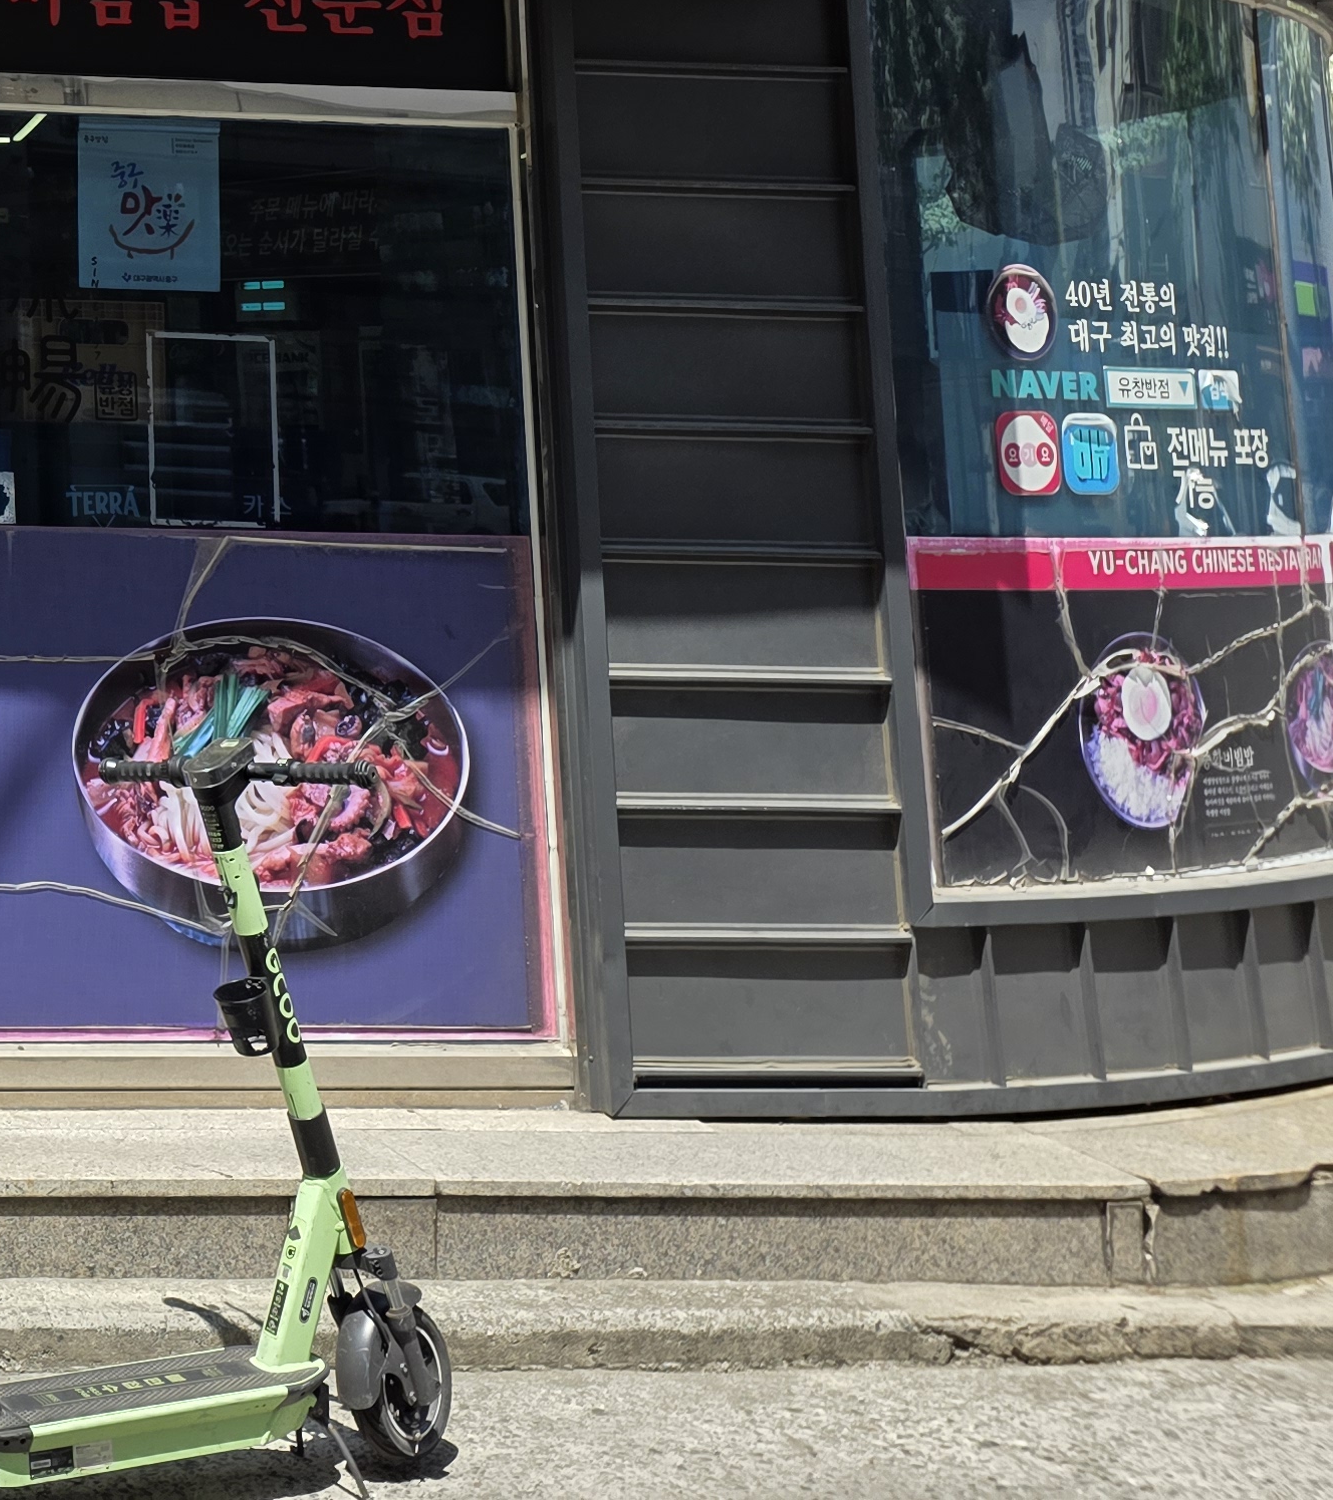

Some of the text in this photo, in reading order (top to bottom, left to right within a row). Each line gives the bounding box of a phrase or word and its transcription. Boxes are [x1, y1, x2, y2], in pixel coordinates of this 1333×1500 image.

[1065, 280, 1176, 315] 40년 전통의
[1068, 320, 1230, 358] 대구 최고의 맛집!!
[991, 369, 1100, 400] NAVER
[1118, 377, 1170, 399] 유창반점
[1006, 444, 1053, 465] 요기요
[1167, 427, 1269, 468] 전메뉴 포장
[66, 486, 140, 518] TERRA
[1088, 550, 1187, 575] YU-CHANG
[1192, 548, 1255, 573] CHINESE
[265, 947, 302, 1044] GCOO
